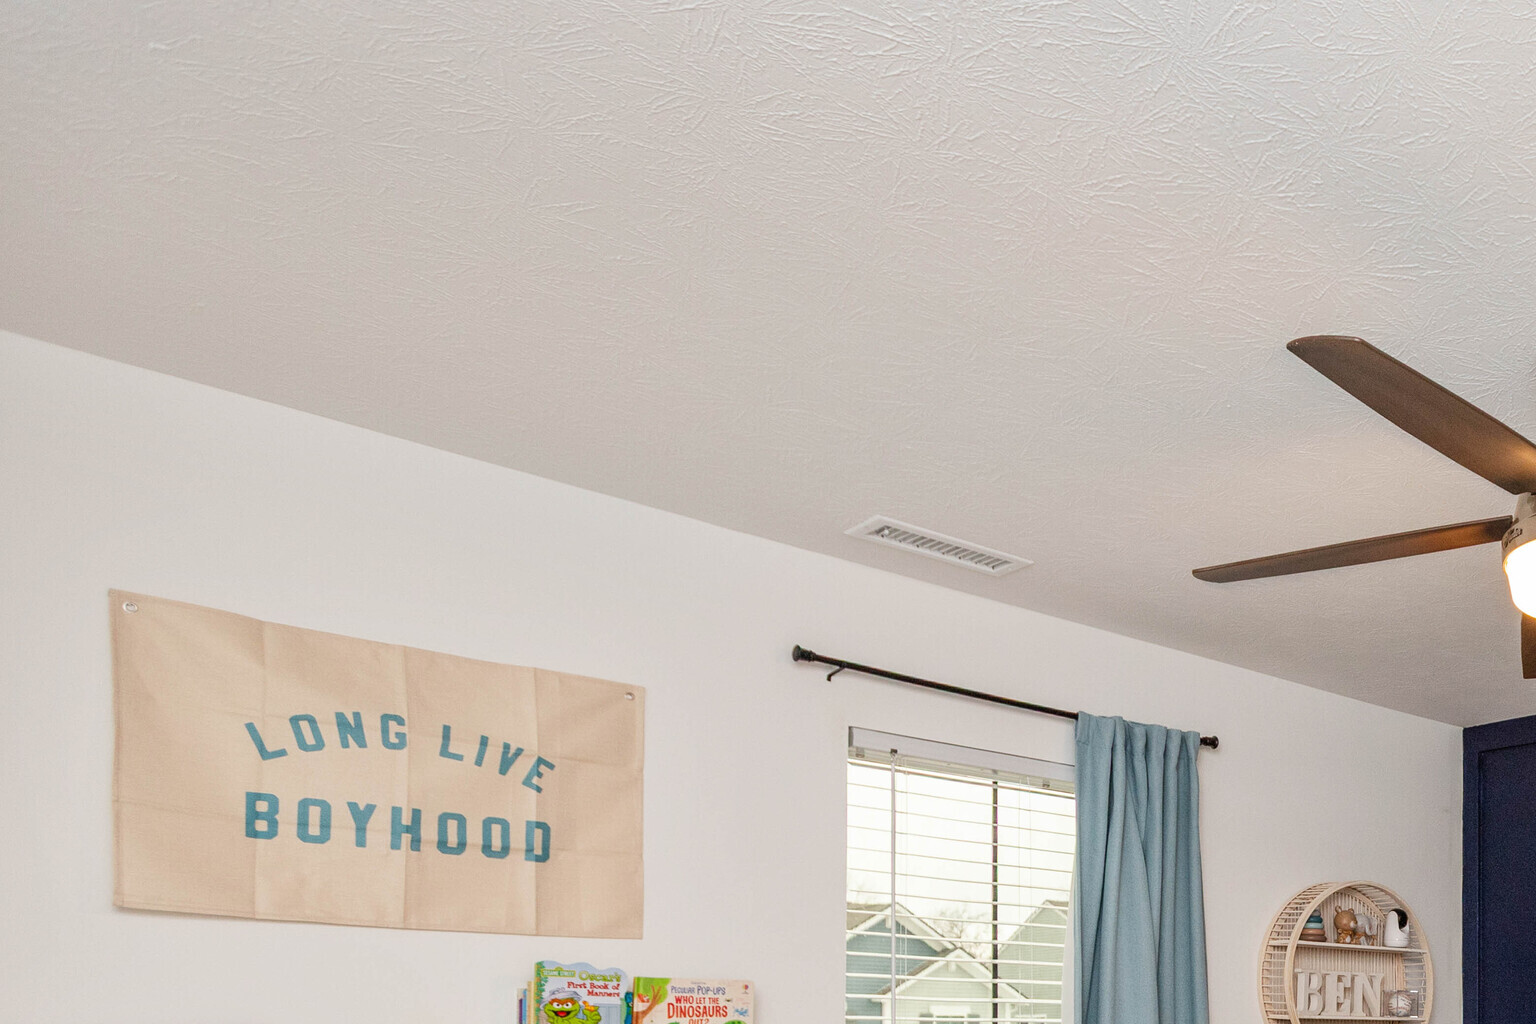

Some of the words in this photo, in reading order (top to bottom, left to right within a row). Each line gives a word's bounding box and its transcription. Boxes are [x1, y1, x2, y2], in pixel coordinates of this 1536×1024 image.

[244, 710, 408, 761] LONG
[438, 724, 556, 794] LIVE
[244, 791, 552, 864] BOYHOOD
[578, 970, 622, 982] Oscar's
[567, 981, 587, 989] First
[589, 982, 609, 990] Book
[671, 985, 696, 994] PECULIAR
[696, 985, 726, 996] POP-UPS
[587, 989, 620, 997] Manners
[1294, 968, 1385, 1017] BEN
[674, 995, 694, 1005] WHO
[695, 997, 706, 1005] LET
[708, 997, 719, 1005] THE
[667, 1002, 728, 1019] DINOSAURS
